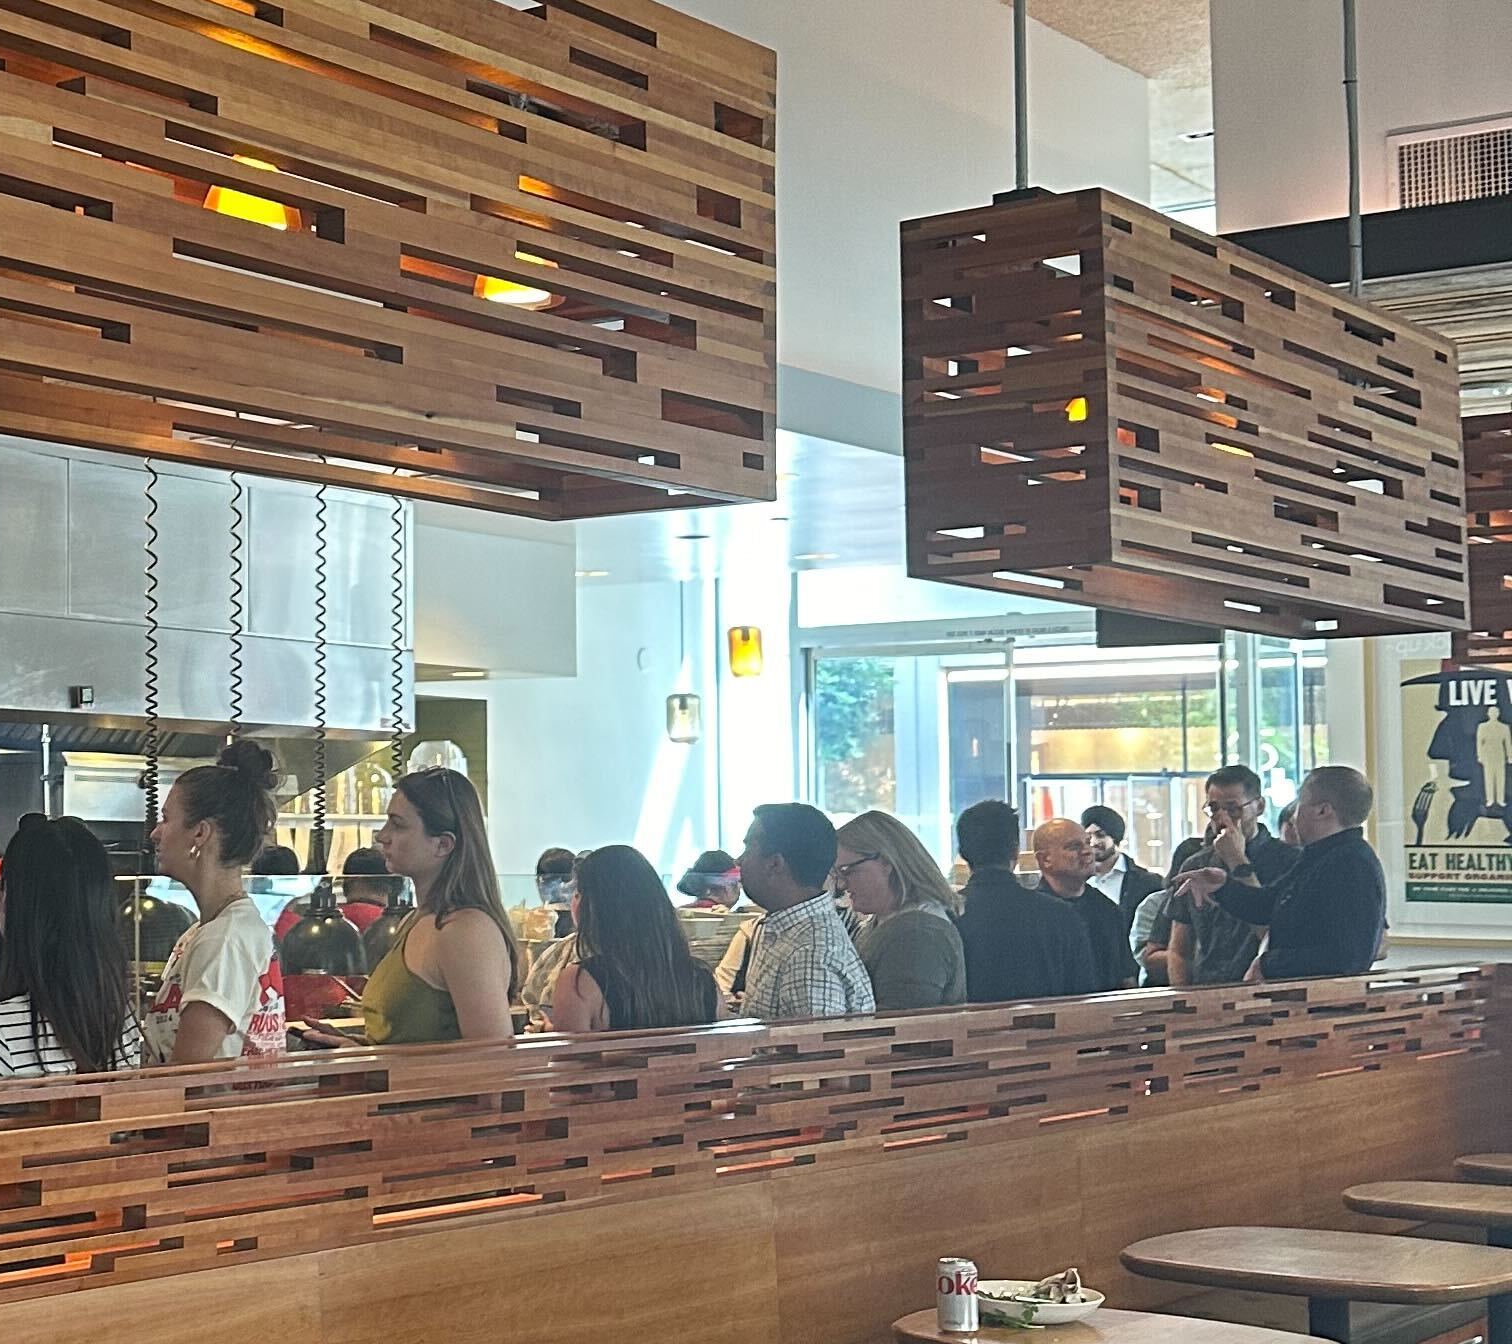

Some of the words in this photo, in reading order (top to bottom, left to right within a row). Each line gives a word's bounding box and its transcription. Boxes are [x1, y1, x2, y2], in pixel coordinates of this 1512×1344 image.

[1448, 679, 1497, 706] LIVE
[1408, 852, 1438, 870] EAT
[1408, 872, 1461, 880] SUPPORT
